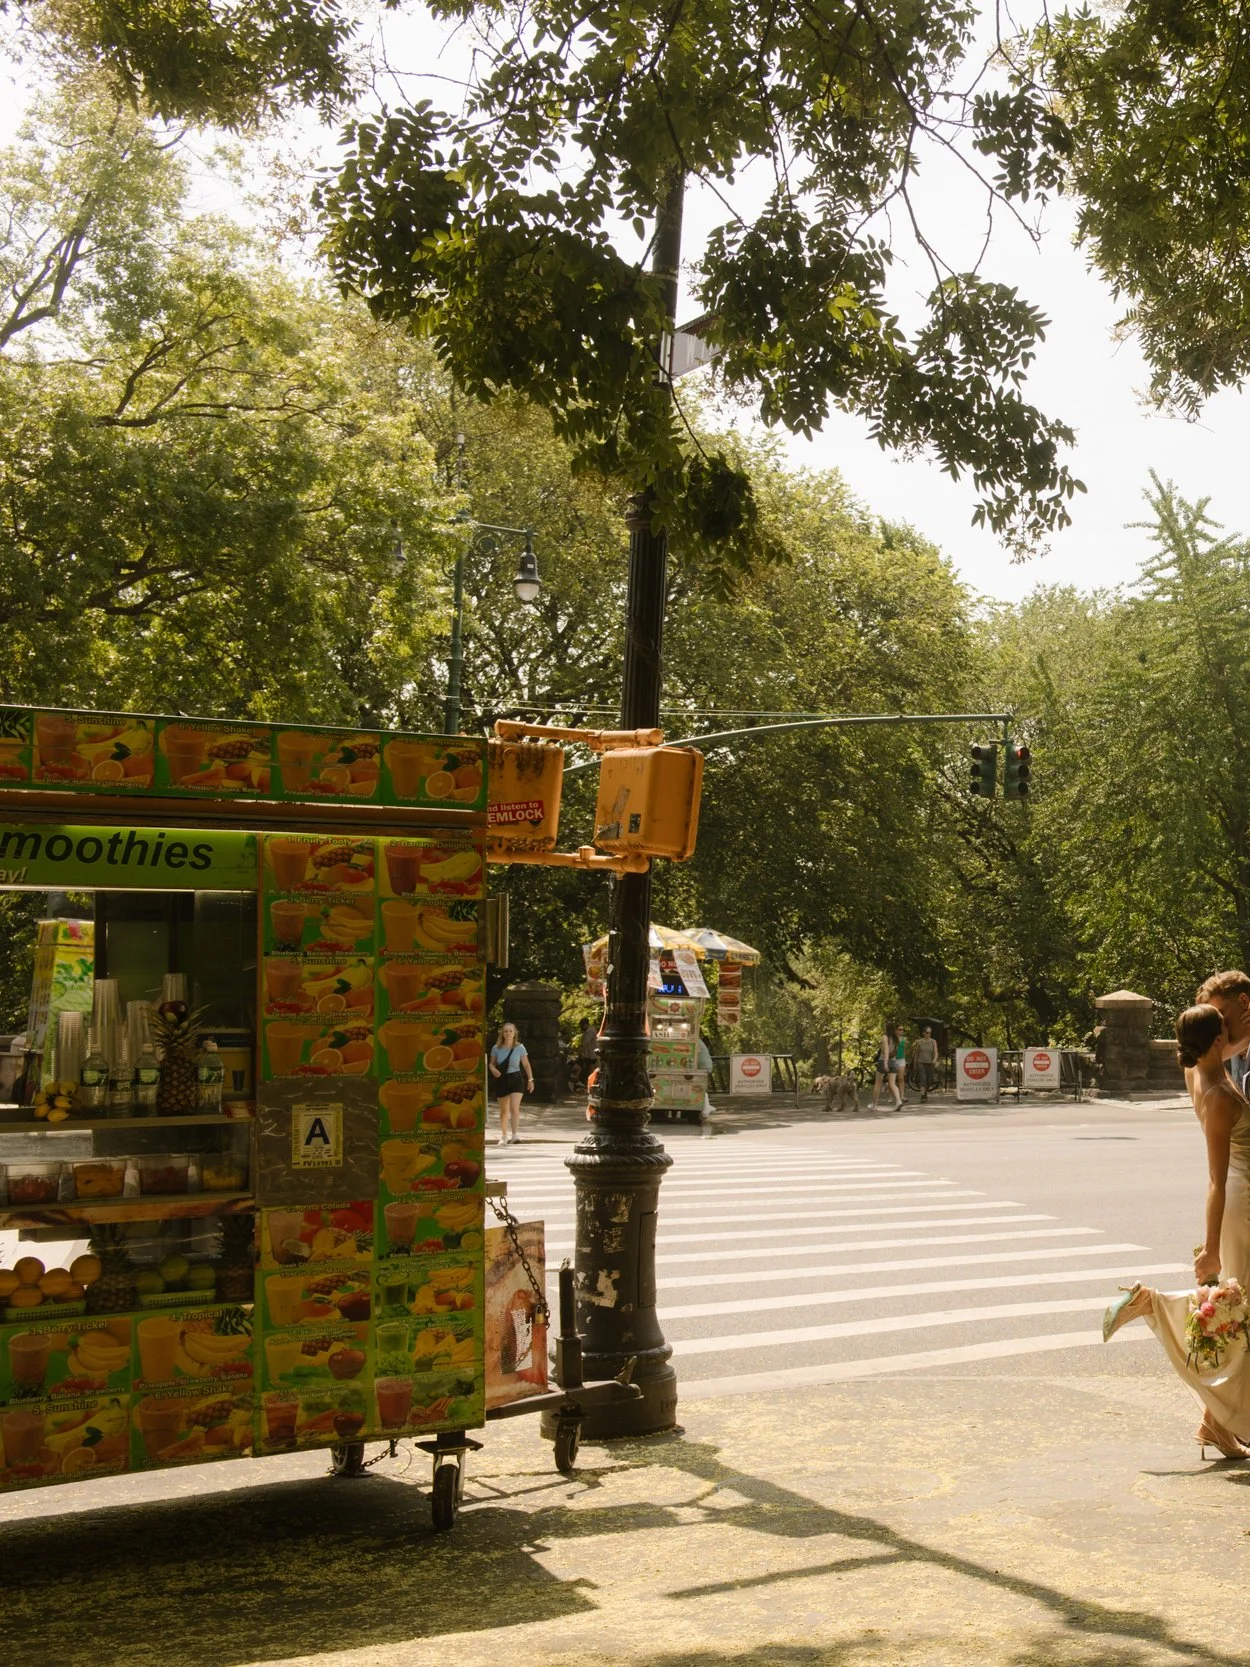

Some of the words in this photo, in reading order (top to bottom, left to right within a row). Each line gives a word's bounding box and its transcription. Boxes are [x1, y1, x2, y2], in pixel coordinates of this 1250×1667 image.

[77, 715, 127, 727] Sunshine
[190, 723, 221, 733] Yellow
[223, 725, 253, 735] Shake
[500, 803, 527, 811] listen
[487, 808, 544, 823] EMLOCK
[298, 836, 324, 845] Fruity
[401, 840, 435, 848] Banana
[437, 842, 473, 850] Delights
[299, 896, 324, 906] Berry
[328, 897, 354, 905] Ticker
[302, 957, 347, 966] Sunshine
[408, 958, 436, 966] Yellow
[438, 958, 465, 966] Shake
[304, 1117, 331, 1146] A
[321, 1201, 351, 1211] Colada
[182, 1309, 223, 1323] Tropical
[43, 1324, 73, 1337] Berry
[77, 1320, 109, 1333] Ticker
[166, 1387, 202, 1400] Yellow
[203, 1383, 234, 1396] Shake
[45, 1399, 99, 1414] Sunshine
